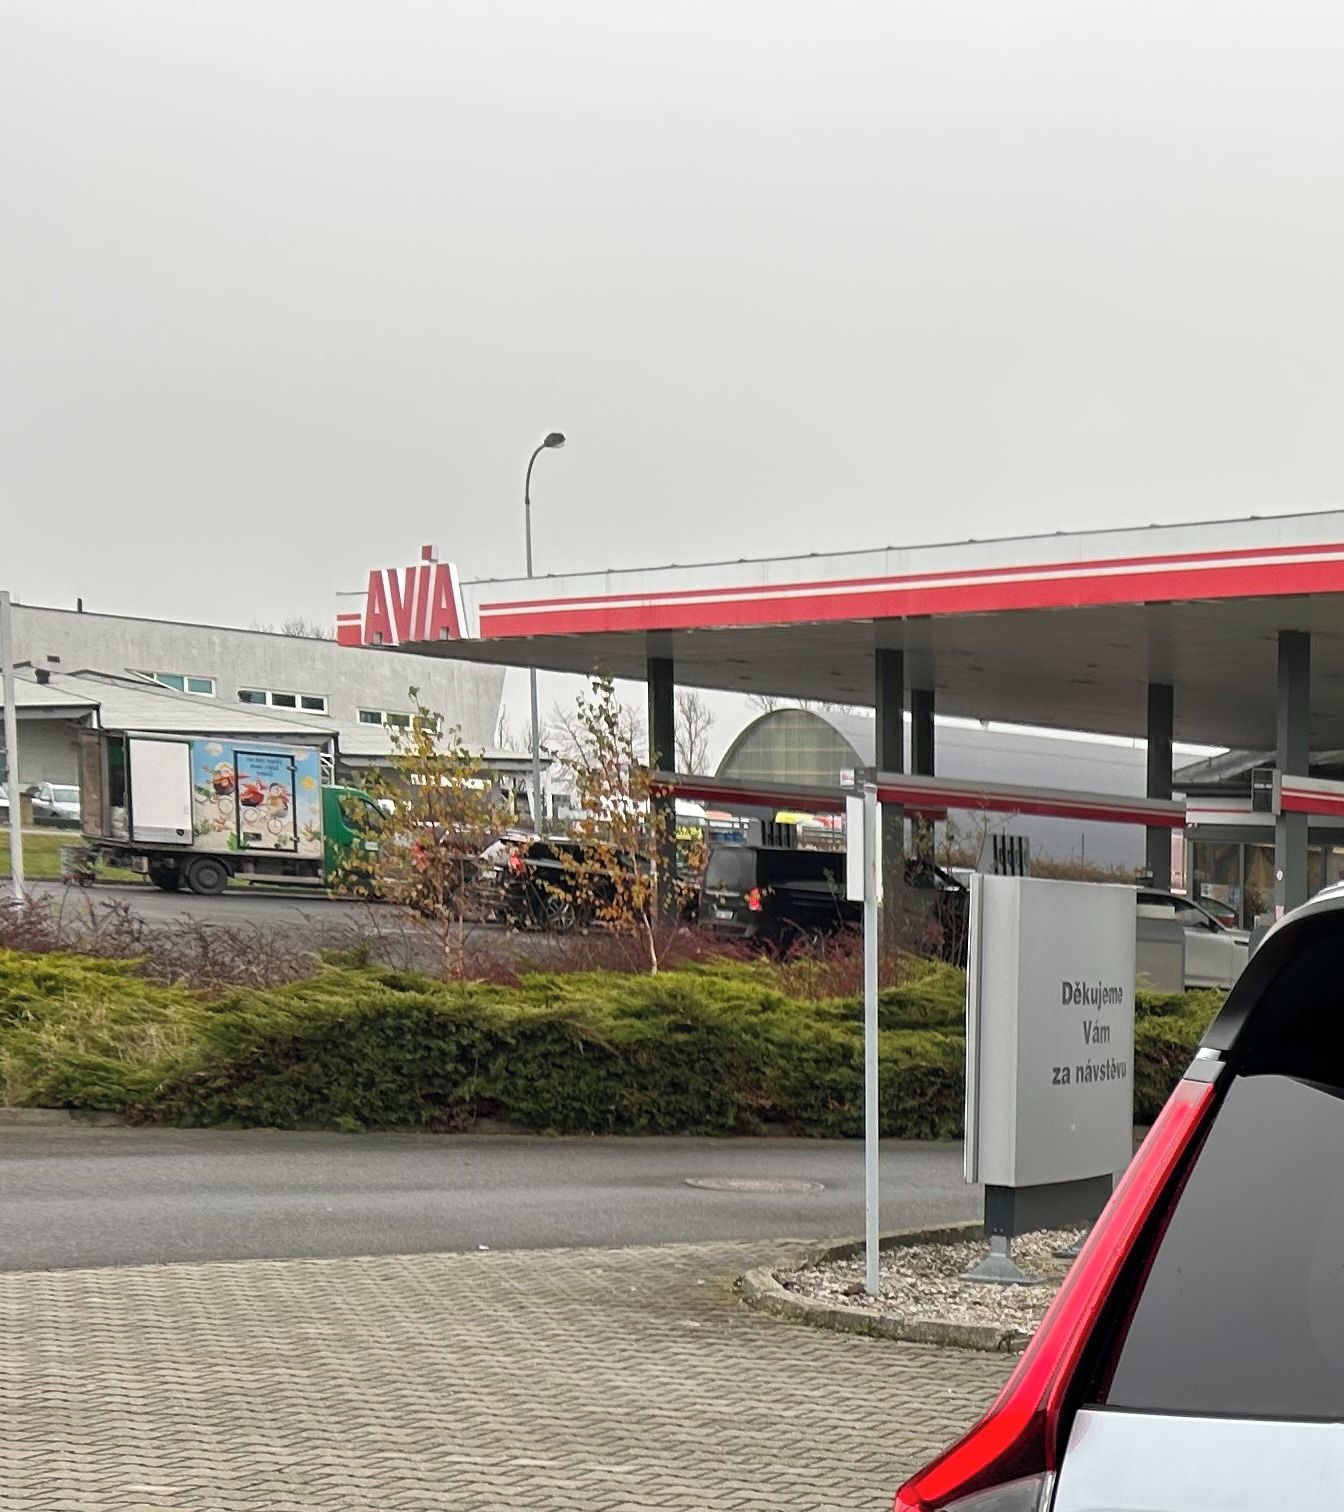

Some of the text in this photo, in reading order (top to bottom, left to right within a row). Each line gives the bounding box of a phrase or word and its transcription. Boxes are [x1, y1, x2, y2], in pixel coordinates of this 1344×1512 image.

[364, 545, 467, 644] AVIA
[1062, 981, 1123, 1010] Děkujeme
[1083, 1020, 1110, 1045] Vám
[1052, 1065, 1071, 1085] za
